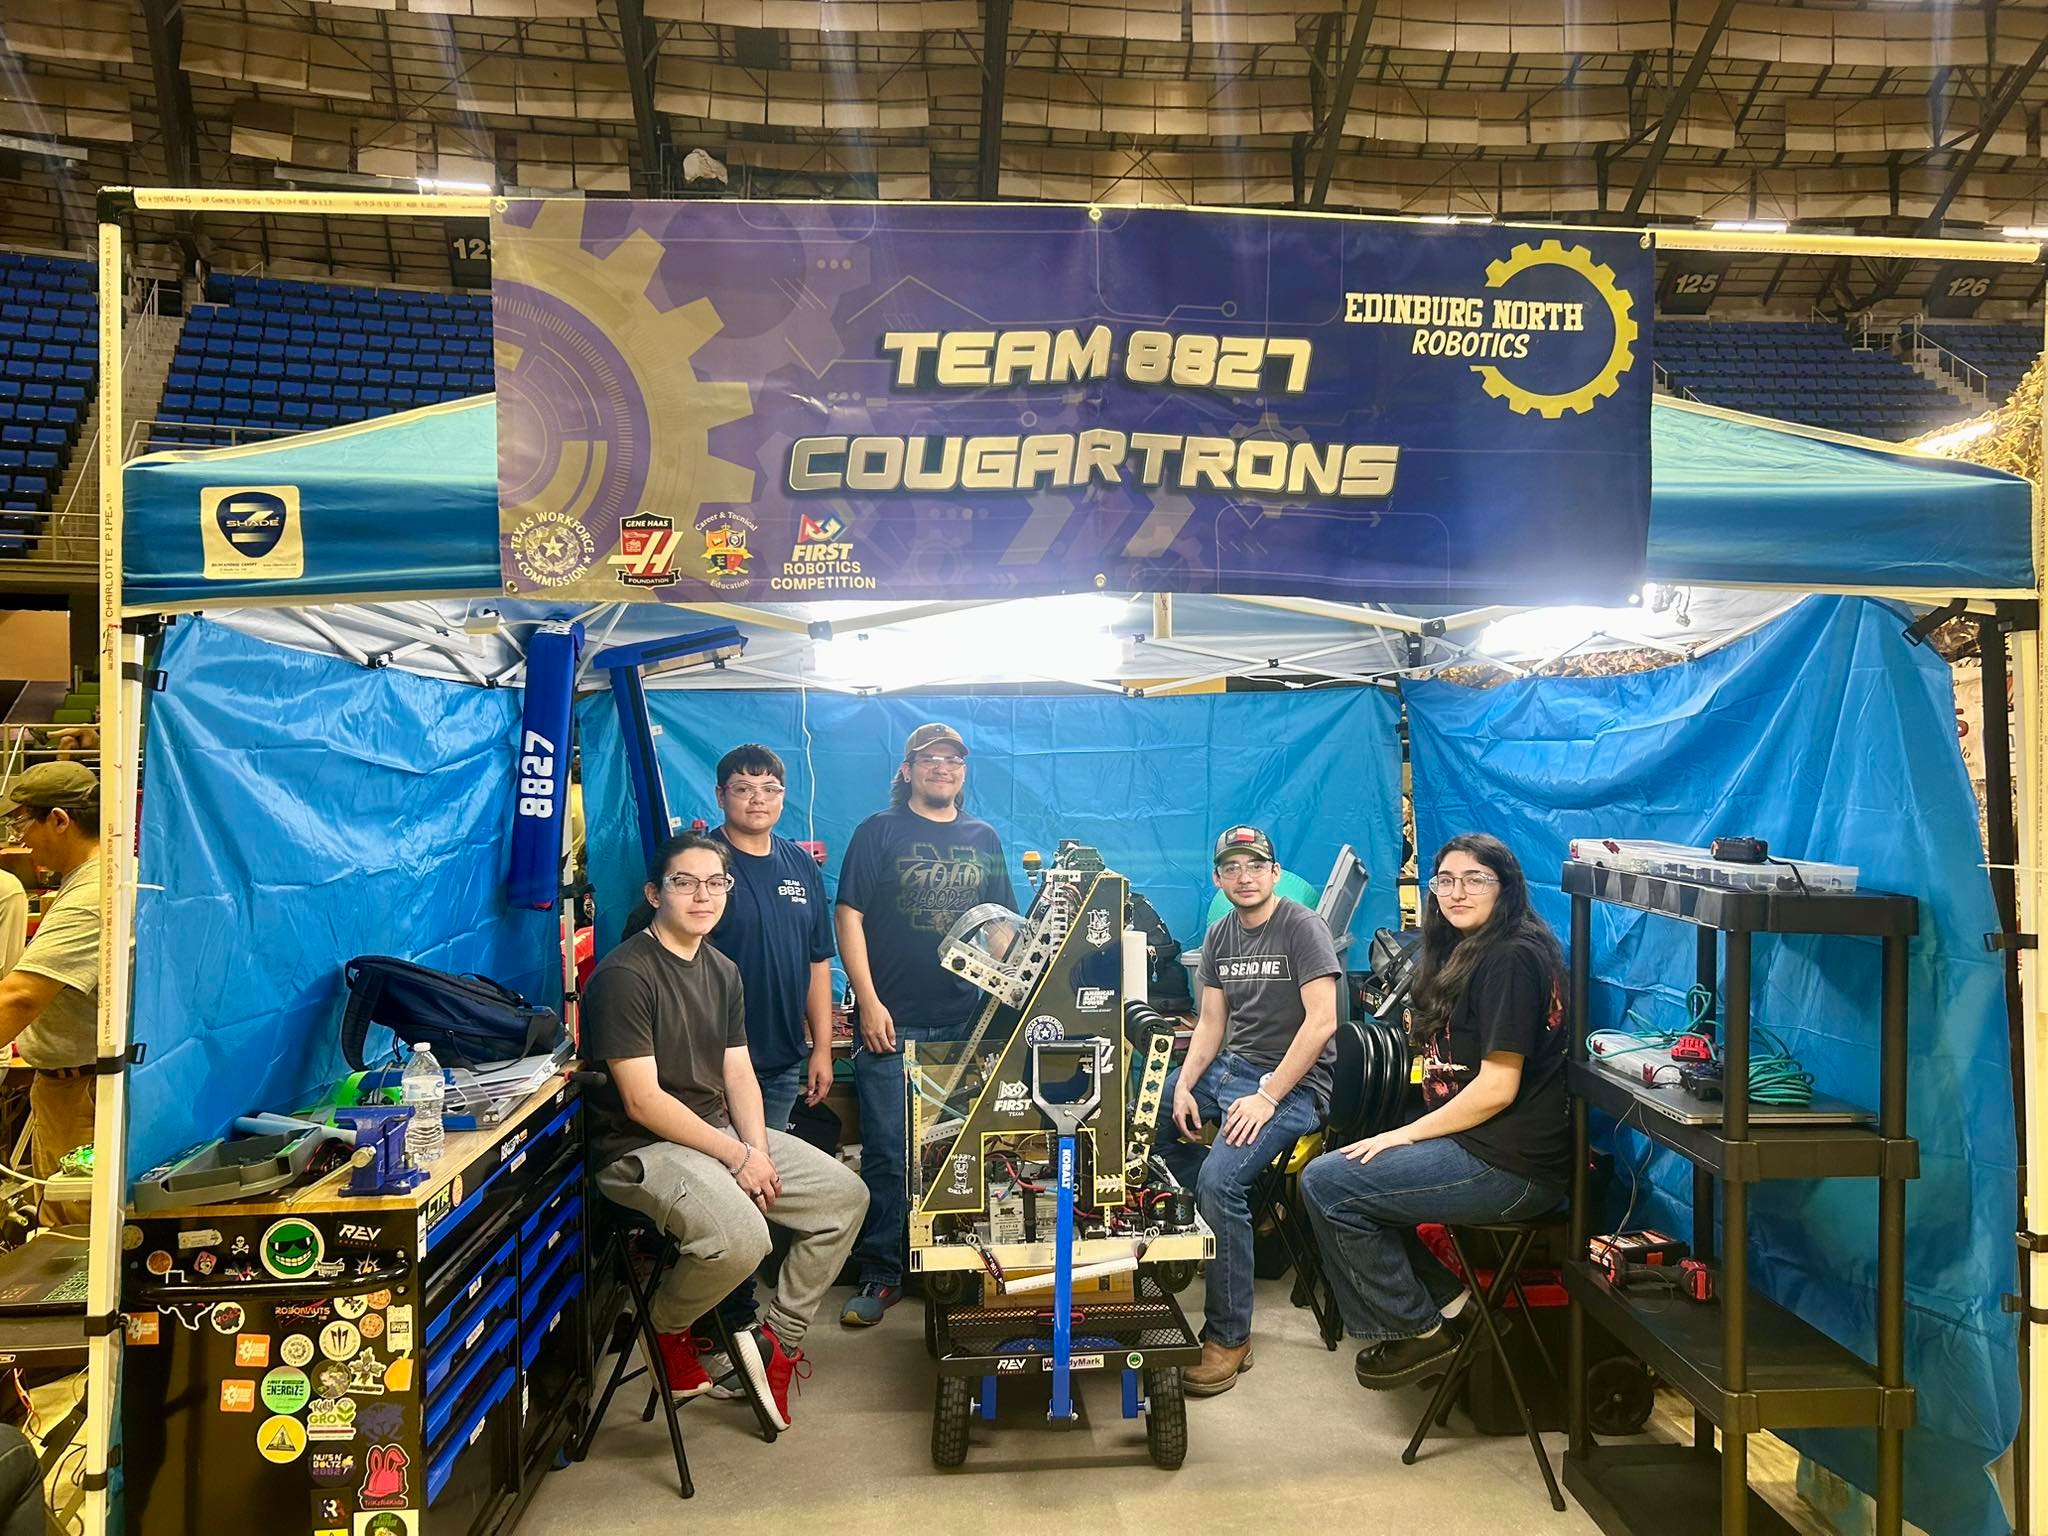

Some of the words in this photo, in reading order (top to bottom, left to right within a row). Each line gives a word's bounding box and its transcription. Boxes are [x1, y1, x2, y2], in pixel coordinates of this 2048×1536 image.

[453, 238, 491, 260] 12
[1676, 273, 1719, 294] 125
[1947, 277, 1991, 297] 126
[1344, 292, 1483, 328] EDINBURG
[1493, 299, 1584, 331] NORTH
[1411, 330, 1530, 359] ROBOTICS
[883, 325, 1112, 387] TEAM
[1125, 331, 1313, 393] 8827
[788, 428, 1400, 498] COUGARTRONS
[226, 519, 280, 527] SHADE
[625, 520, 646, 528] GENE
[647, 519, 669, 527] HAAS
[695, 513, 718, 532] Career
[719, 511, 726, 519] &
[511, 516, 535, 549] TEXAS
[536, 511, 595, 553] WORKFORCE
[791, 543, 854, 562] FIRST
[518, 561, 588, 587] COMMISSION
[783, 561, 862, 575] ROBOTICS
[104, 548, 114, 618] CHARLOTTE
[628, 577, 670, 585] FOUNDATION
[710, 578, 750, 590] Education
[770, 577, 876, 590] COMPETITION
[519, 730, 555, 818] 8827
[777, 885, 806, 897] 8827
[1230, 961, 1260, 976] SEND
[1261, 960, 1281, 975] ME
[993, 1098, 1033, 1112] FIRST
[1061, 1149, 1071, 1190] KOBALT
[339, 1224, 382, 1241] REV
[275, 1306, 331, 1315] ROBONAUTS
[997, 1358, 1027, 1370] REV
[267, 1385, 305, 1396] ENERGIZE
[309, 1413, 337, 1424] GRO
